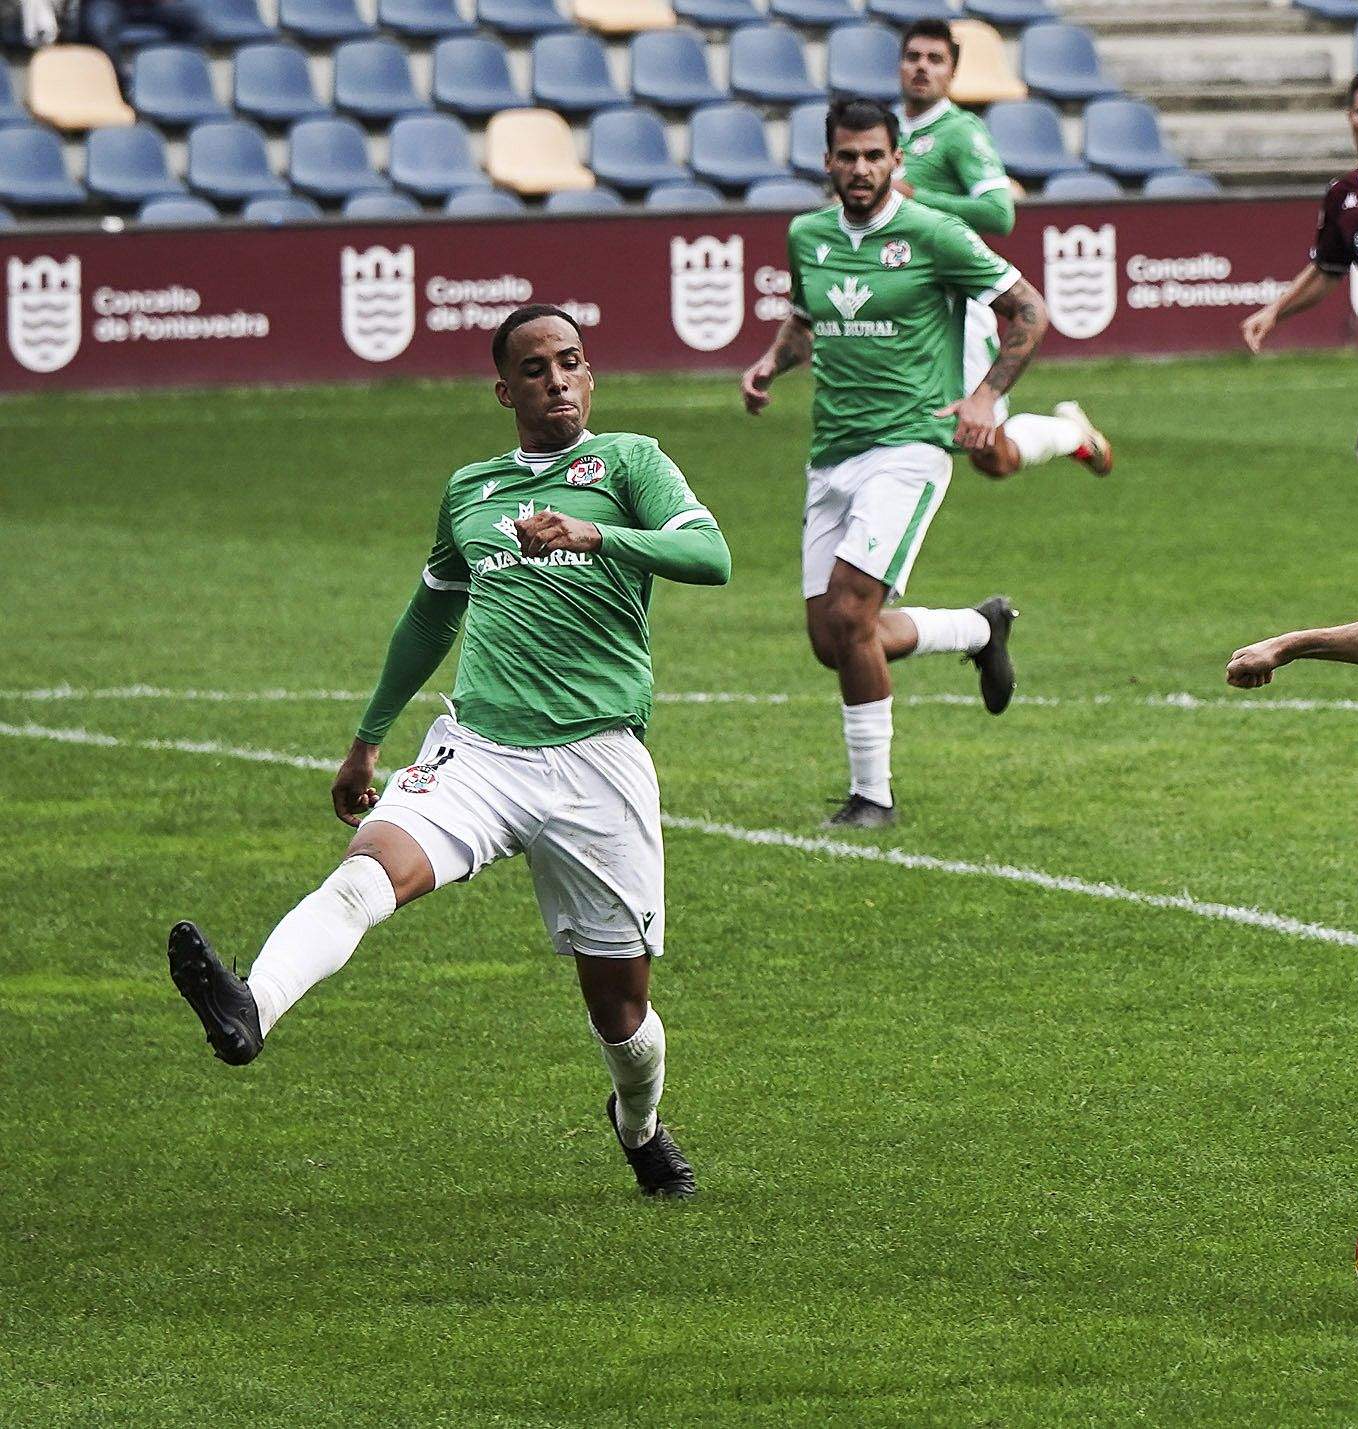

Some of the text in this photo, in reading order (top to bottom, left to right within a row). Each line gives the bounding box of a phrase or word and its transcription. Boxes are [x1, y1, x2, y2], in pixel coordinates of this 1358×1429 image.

[1126, 253, 1232, 283] Concello
[92, 285, 201, 316] Concello
[425, 275, 534, 305] Concello
[1127, 284, 1161, 309] de
[93, 310, 270, 342] de Pontevedra
[426, 306, 462, 331] de
